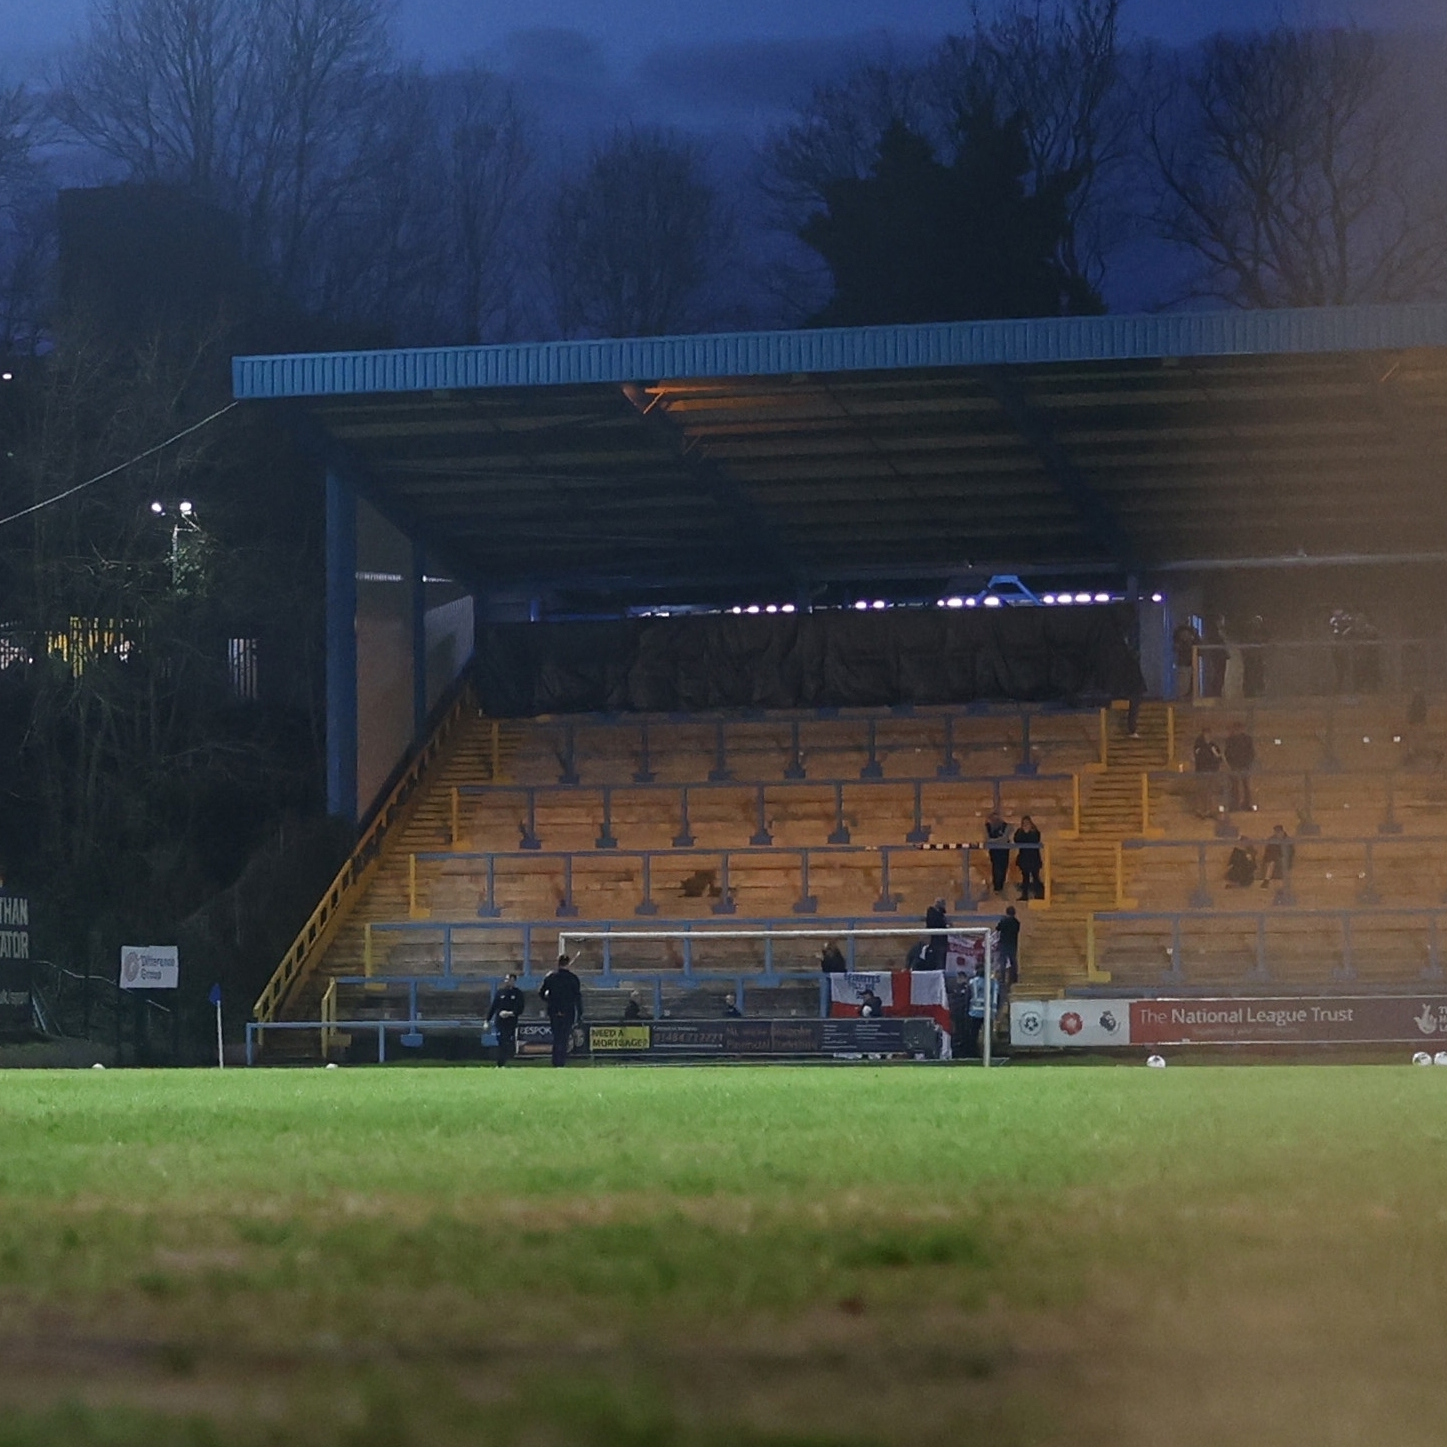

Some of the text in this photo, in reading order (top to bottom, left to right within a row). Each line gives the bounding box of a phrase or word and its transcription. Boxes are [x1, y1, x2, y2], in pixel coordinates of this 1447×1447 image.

[1140, 1007, 1354, 1026] The National League Trust
[520, 1027, 552, 1035] BESPOK
